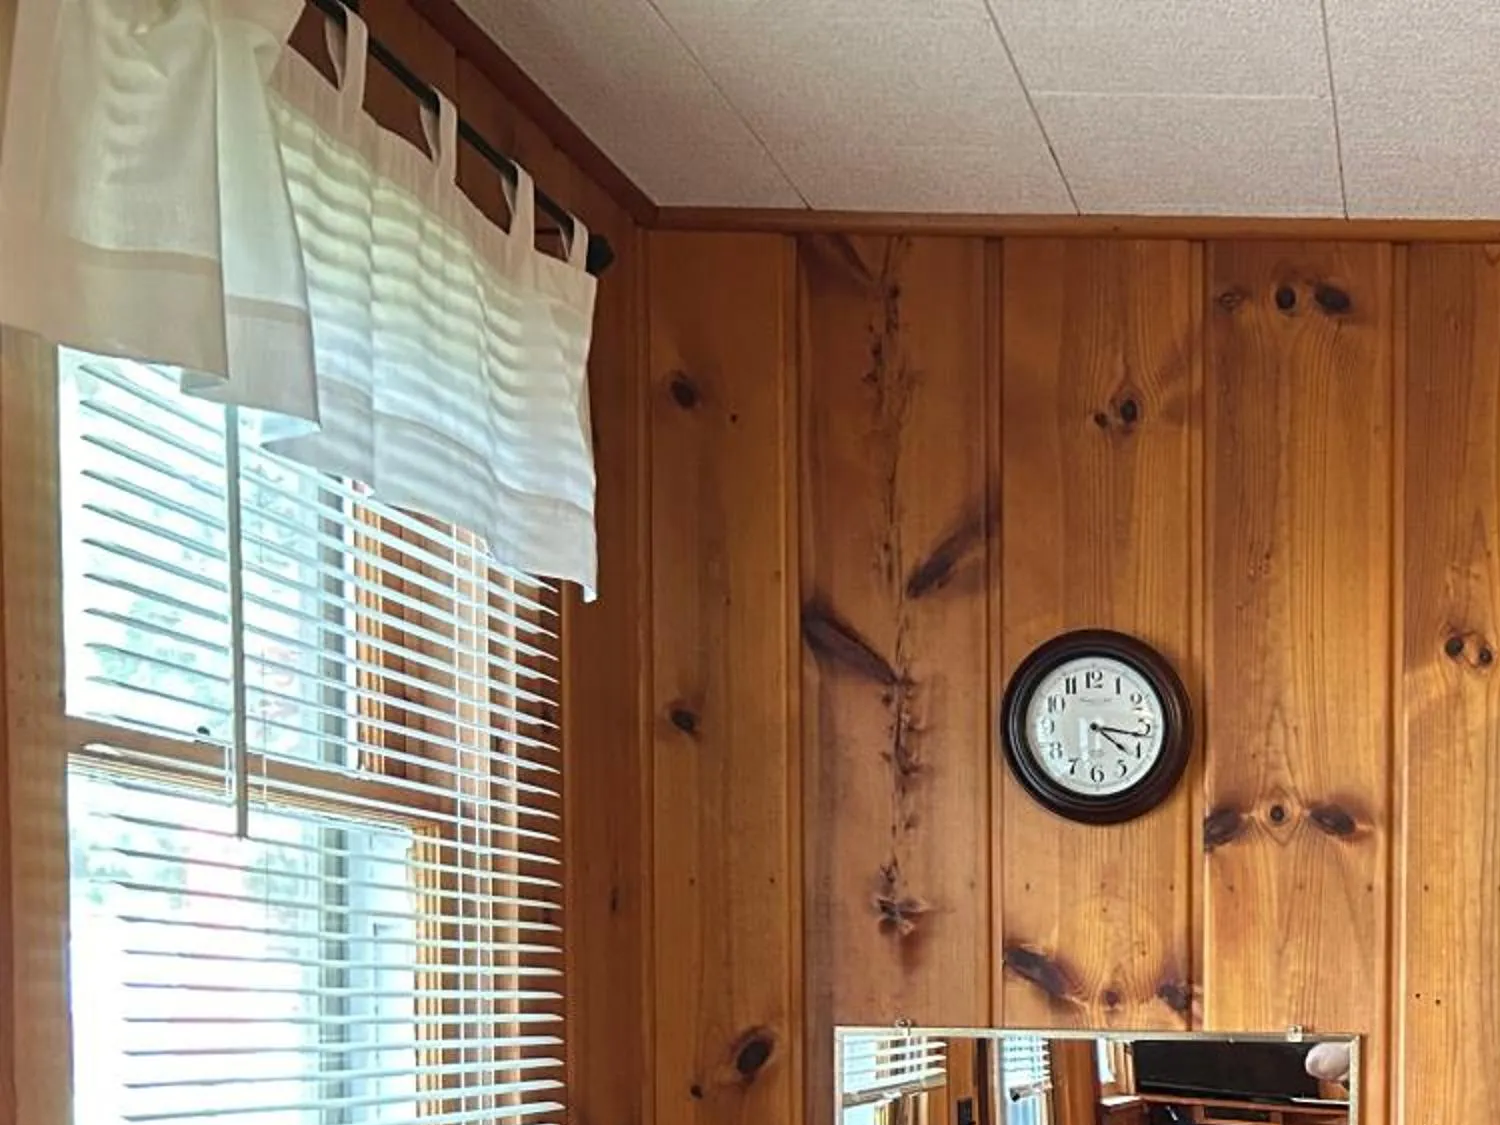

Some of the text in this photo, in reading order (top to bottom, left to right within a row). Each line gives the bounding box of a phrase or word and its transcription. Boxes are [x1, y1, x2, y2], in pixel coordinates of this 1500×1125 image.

[1065, 677, 1077, 695] 11
[1085, 670, 1104, 689] 12
[1115, 677, 1121, 695] 1
[1047, 694, 1065, 713] 10
[1130, 693, 1142, 710] 2
[1041, 717, 1055, 735] 9
[1049, 741, 1063, 759] 8
[1067, 757, 1080, 775] 7
[1090, 765, 1105, 782] 6
[1115, 759, 1128, 777] 5
